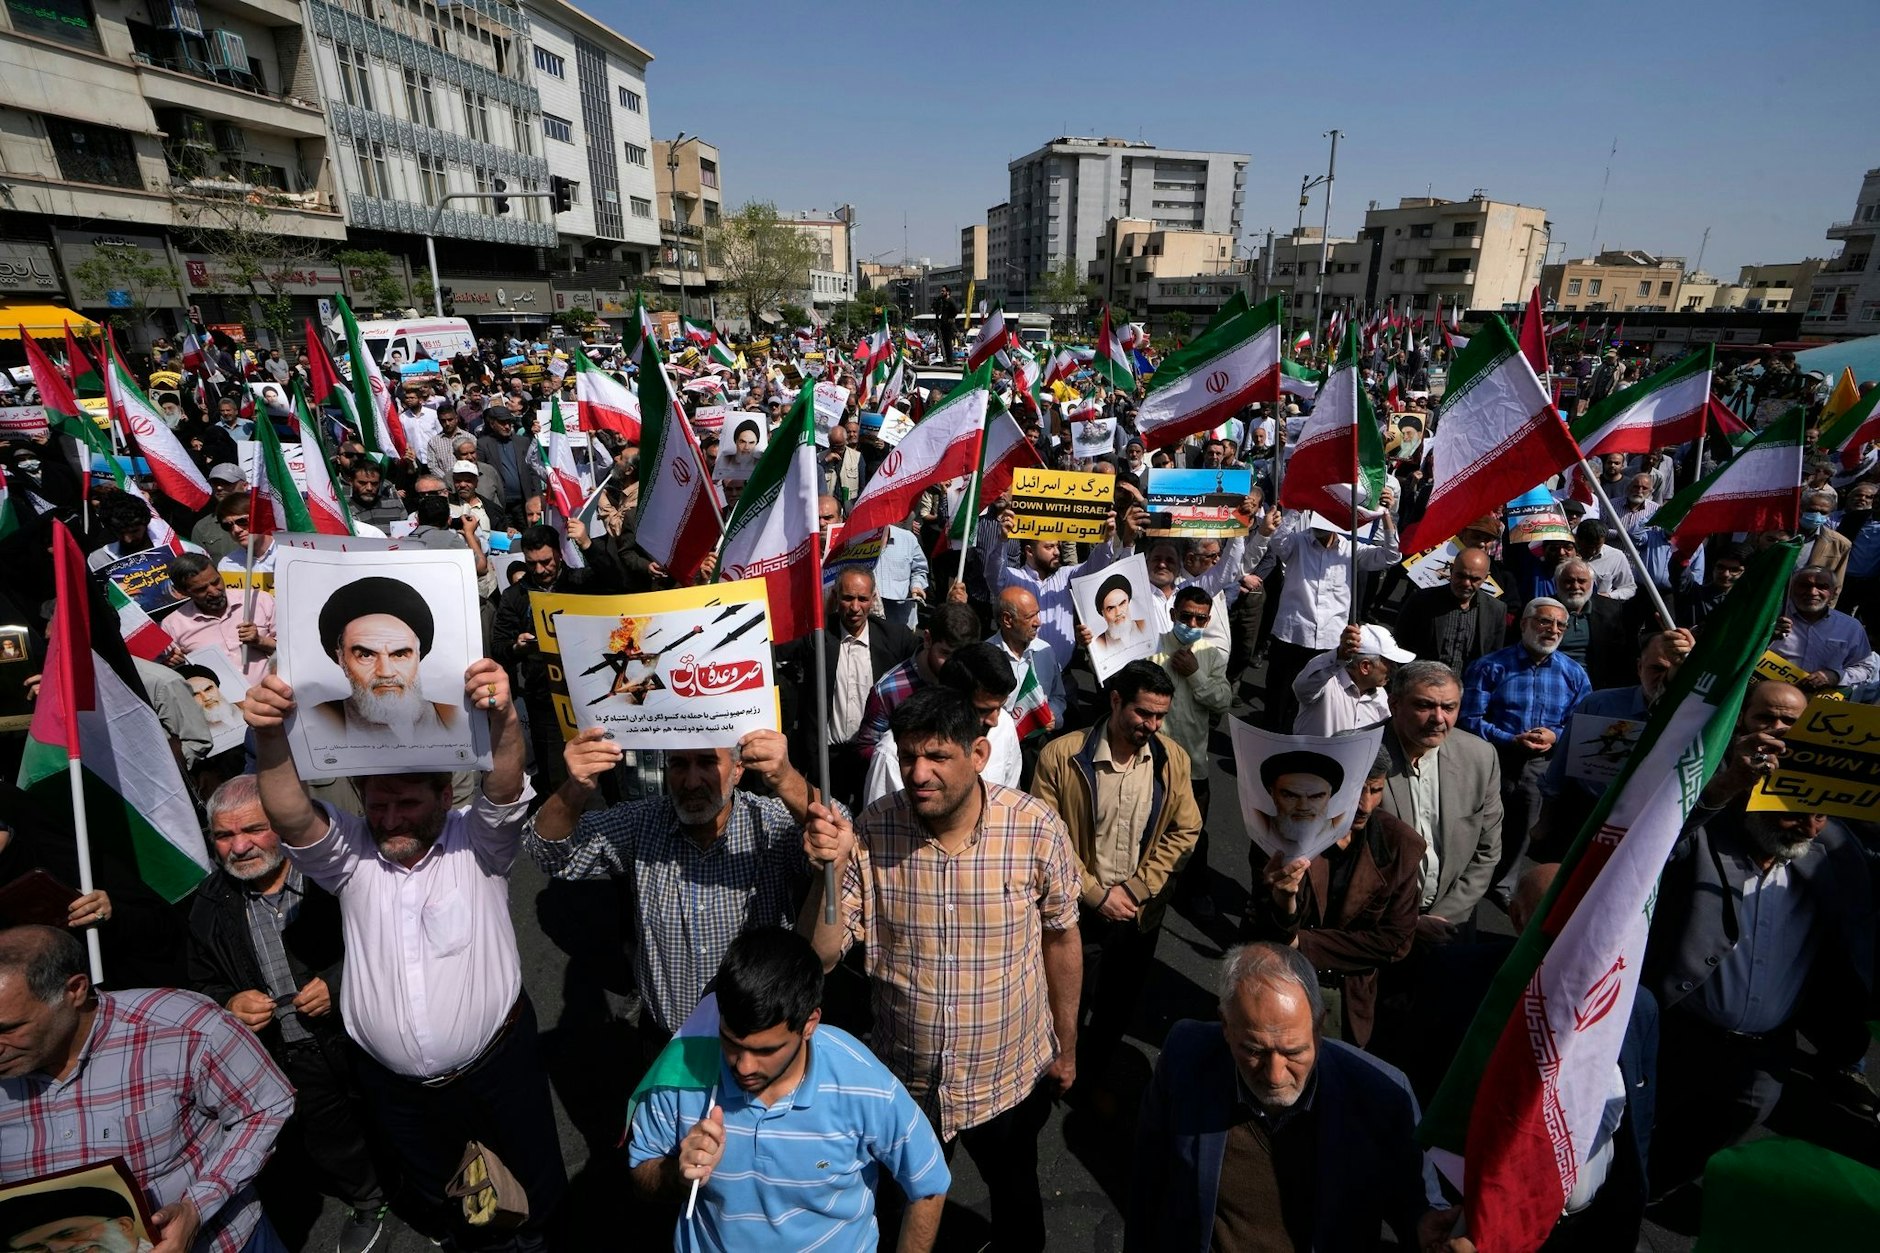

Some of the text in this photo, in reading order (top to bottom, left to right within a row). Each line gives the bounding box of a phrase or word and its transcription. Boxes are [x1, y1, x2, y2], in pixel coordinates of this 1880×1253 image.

[1016, 475, 1109, 497] مرگ بر اسرائیل
[1163, 496, 1190, 505] خواهد
[1191, 495, 1206, 505] آزاد
[1012, 501, 1108, 515] DOWN WITH ISRAEL
[1067, 523, 1105, 538] الموت
[686, 712, 704, 720] حمله
[703, 711, 713, 720] با
[713, 709, 745, 720] صهیونیستی
[745, 707, 761, 716] رژیم
[610, 714, 629, 722] اشتباه
[630, 714, 646, 723] ایران
[647, 713, 679, 722] کنسولگری
[680, 713, 687, 721] به
[640, 726, 661, 734] خواهد
[706, 724, 719, 732] تنبیه
[721, 723, 734, 731] باید
[1806, 712, 1880, 746] ریکا
